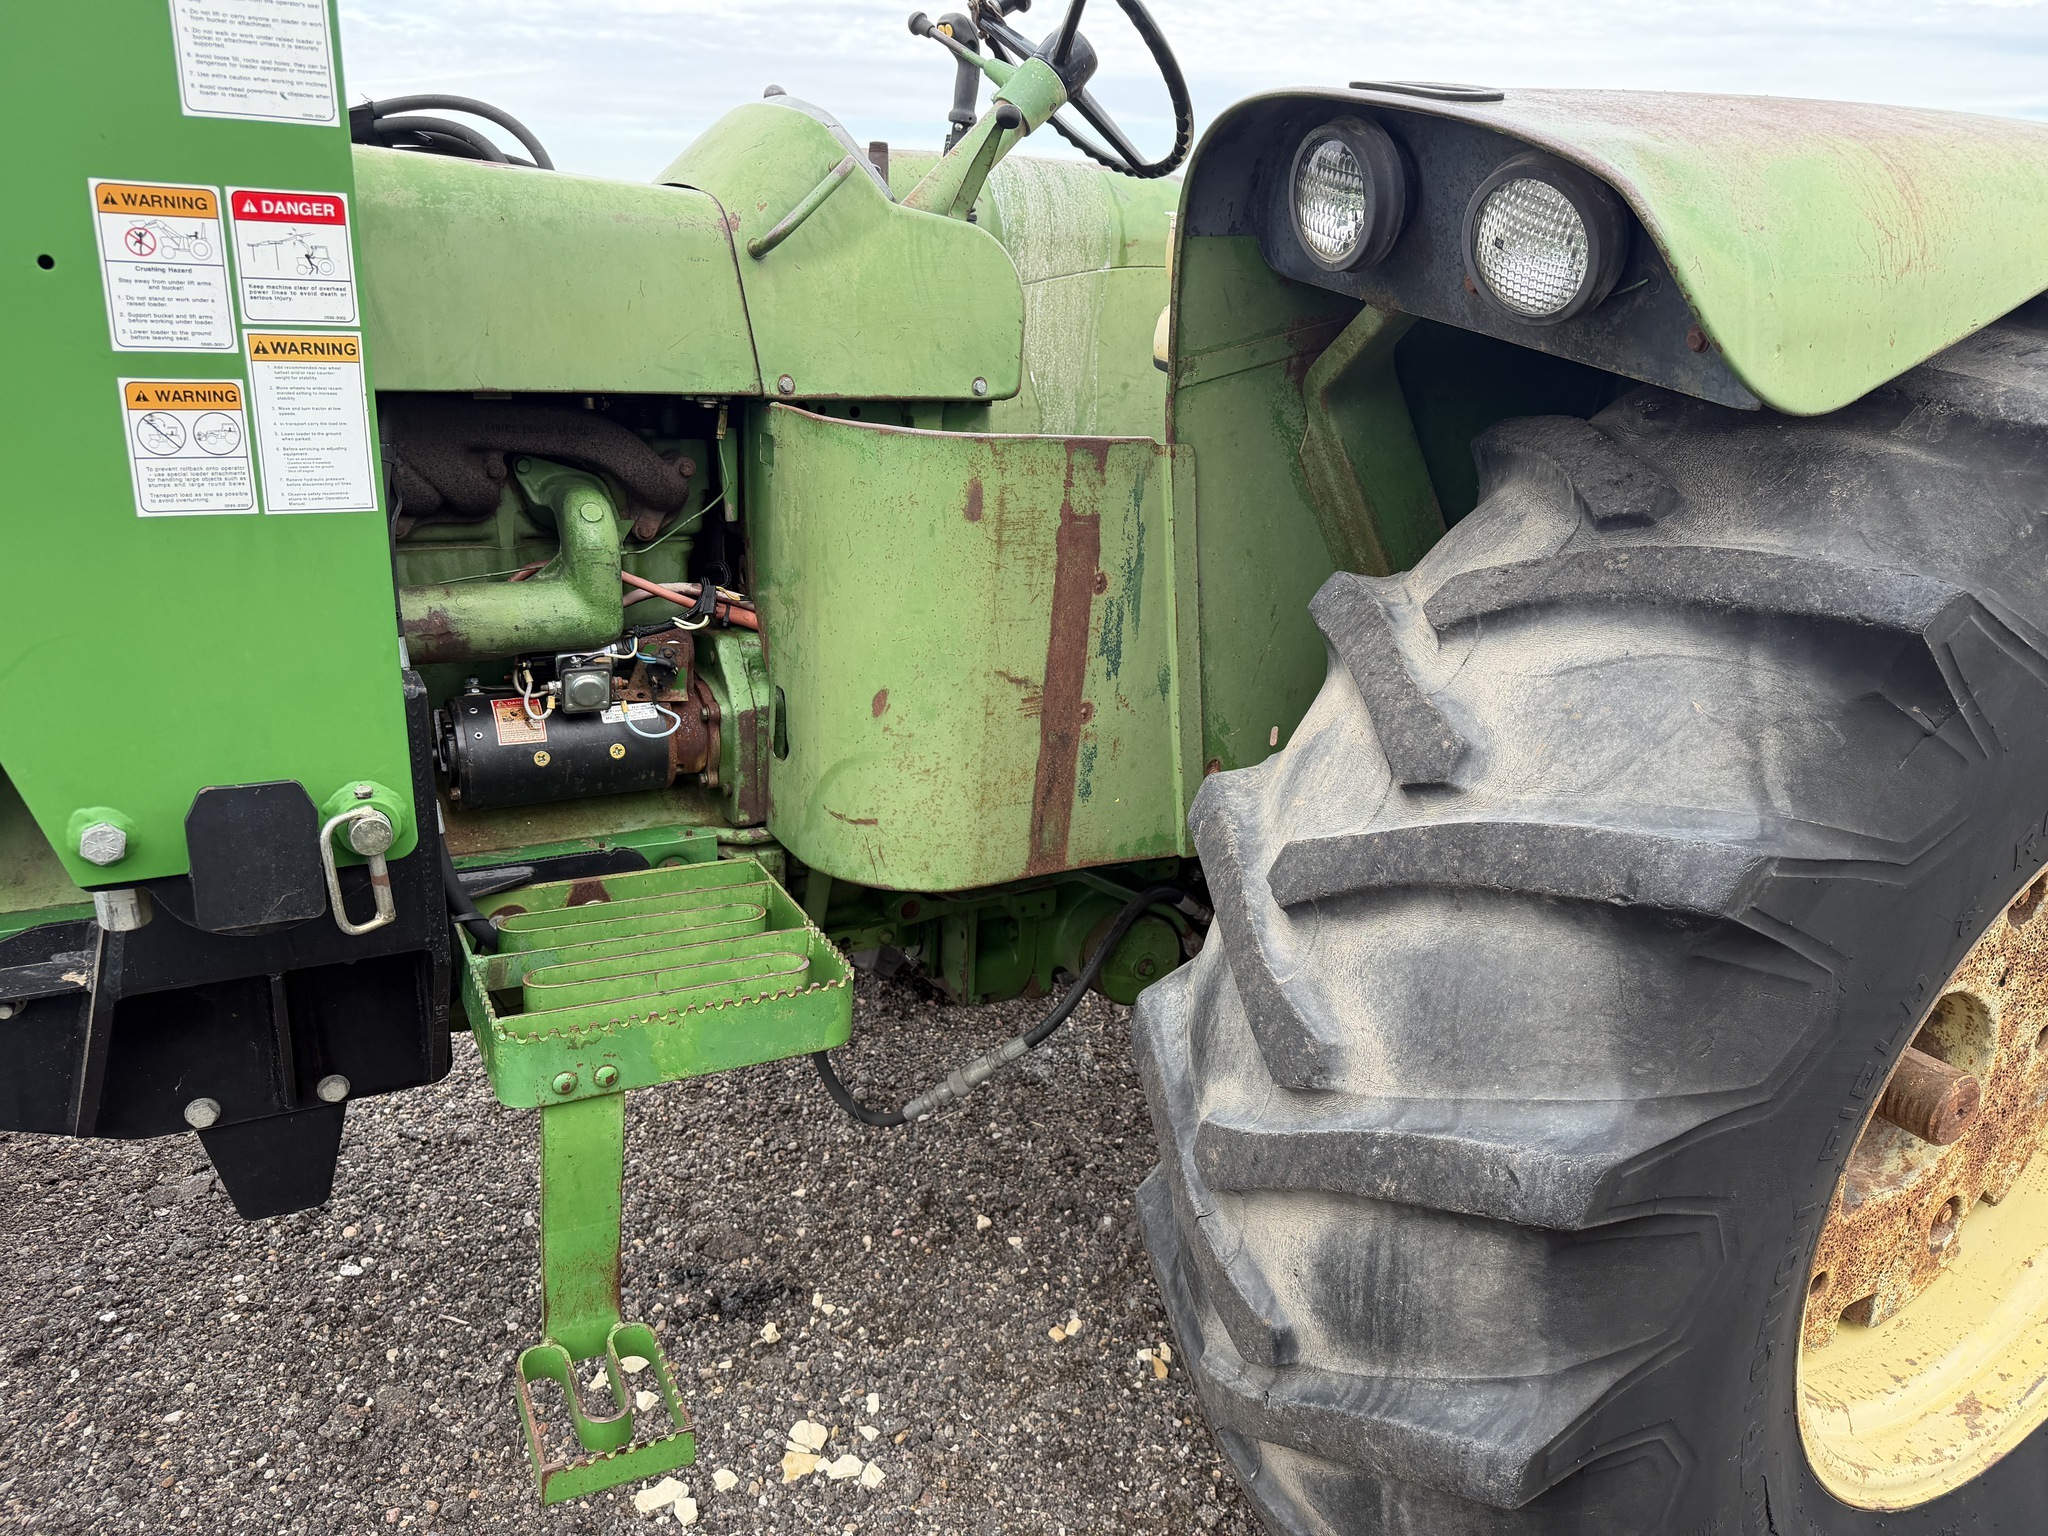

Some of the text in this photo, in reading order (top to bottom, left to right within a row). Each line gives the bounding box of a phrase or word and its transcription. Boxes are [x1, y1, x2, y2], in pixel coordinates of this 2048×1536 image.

[121, 193, 208, 210] WARNING
[262, 200, 335, 217] DANGER
[270, 341, 356, 356] WARNING
[155, 390, 237, 402] WARNING
